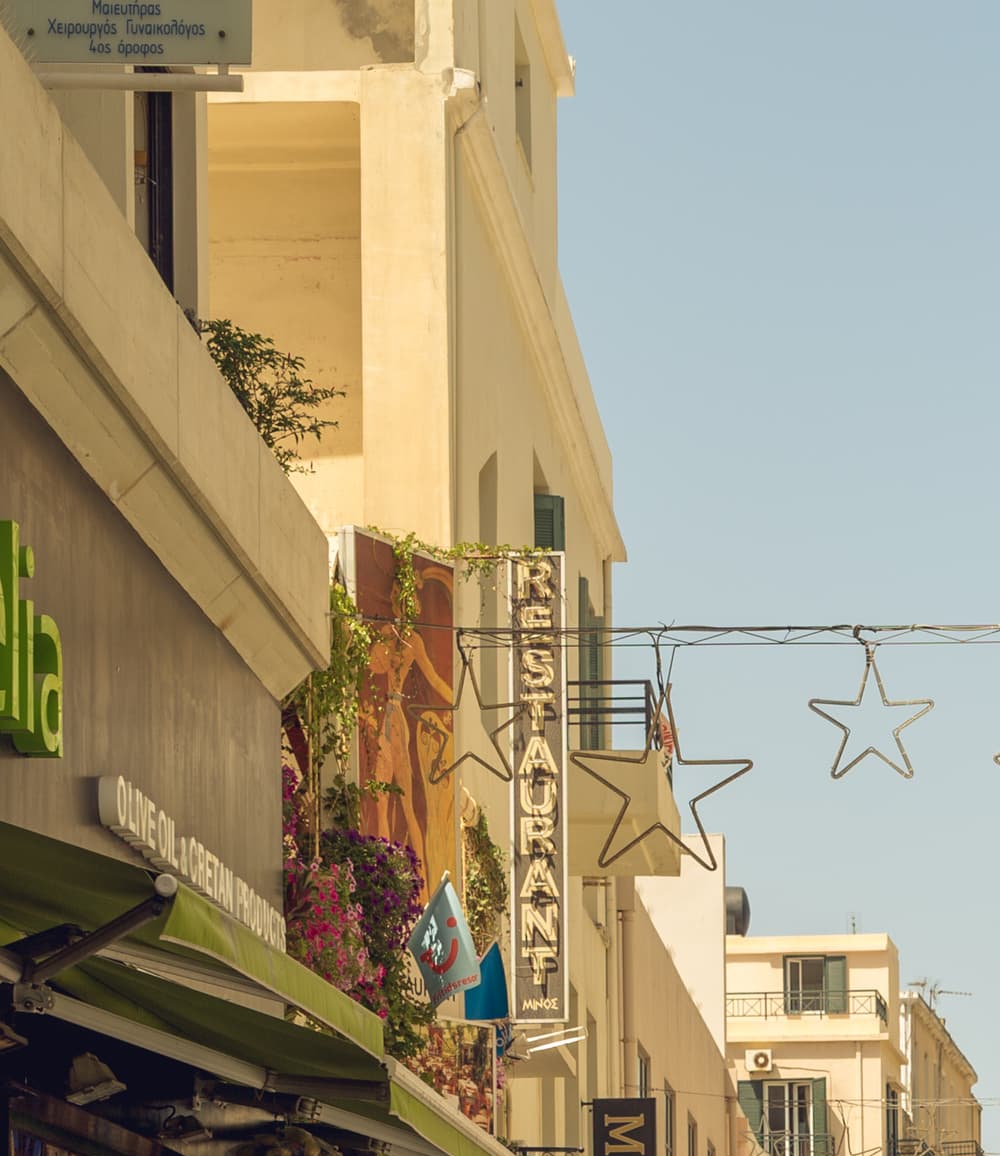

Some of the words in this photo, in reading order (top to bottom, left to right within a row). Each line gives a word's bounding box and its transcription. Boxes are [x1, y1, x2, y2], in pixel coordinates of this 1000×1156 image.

[48, 19, 117, 38] Χειρουργός
[126, 19, 206, 39] Γυναικολόγος
[89, 41, 111, 53] 4ος
[118, 40, 164, 57] όροφος
[0, 519, 63, 758] lia
[519, 561, 560, 984] RESTAURANT
[117, 775, 156, 850] OLIVE
[158, 809, 178, 867] OIL
[181, 836, 188, 876] &
[189, 836, 233, 913] CRETAN
[236, 876, 287, 953] PRODUCTS
